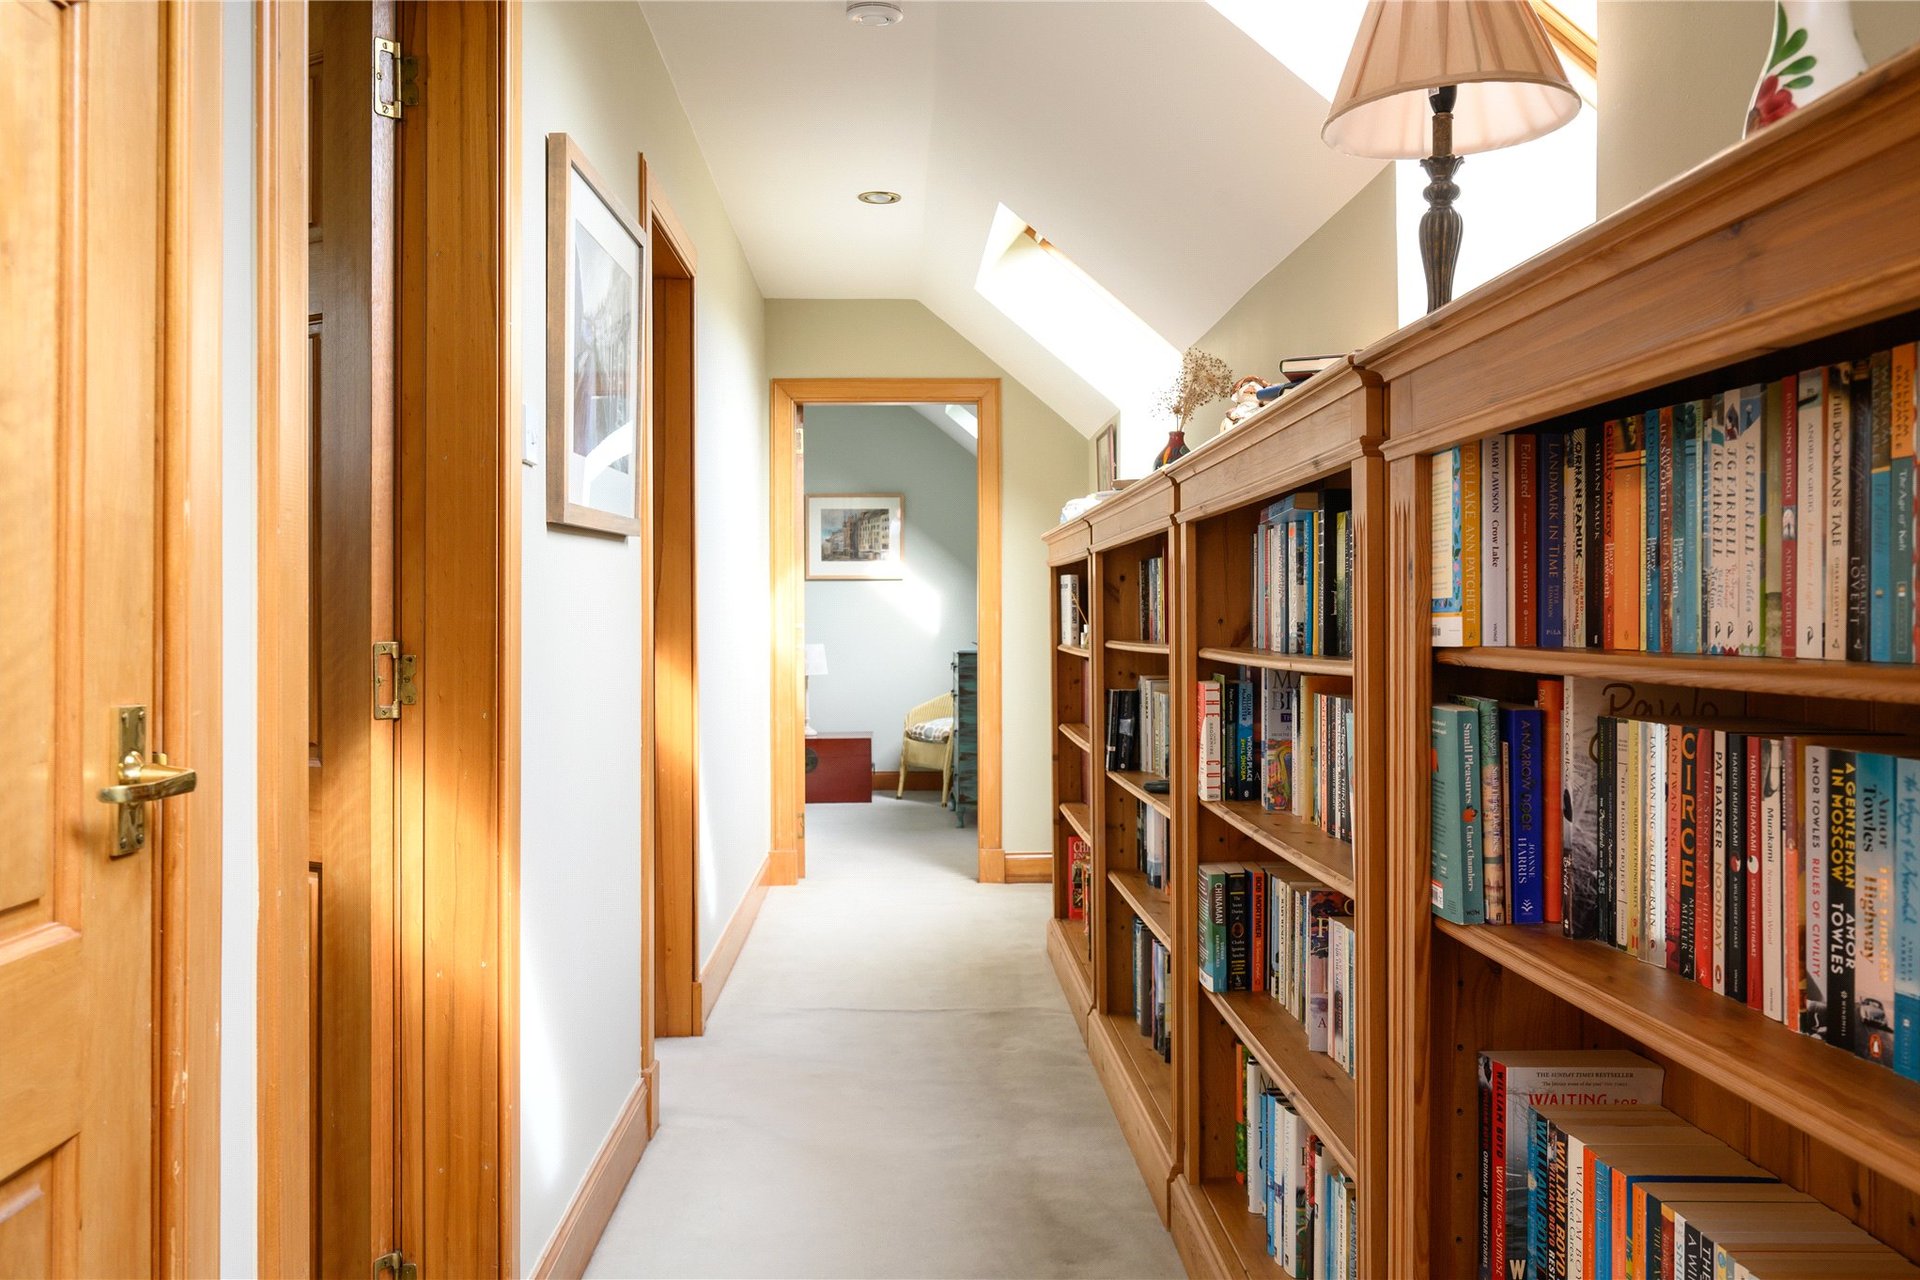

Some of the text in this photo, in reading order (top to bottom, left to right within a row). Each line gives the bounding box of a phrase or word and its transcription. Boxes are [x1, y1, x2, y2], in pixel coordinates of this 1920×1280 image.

[1832, 394, 1842, 419] THE
[1871, 365, 1880, 462] DALRYMPLE
[1880, 366, 1890, 446] WILLIAM
[1895, 364, 1903, 451] DALRYMPLE
[1903, 369, 1911, 437] WILLIAM
[1520, 444, 1531, 498] Educated
[1784, 392, 1793, 500] ROMANNO BRIDGE
[1807, 422, 1815, 513] ANDREW GREIG
[1491, 441, 1499, 513] MARY LAWSON
[1575, 441, 1583, 559] ORHAN PAMUK
[1647, 470, 1657, 527] VIRGIN
[1896, 489, 1907, 513] Age
[1898, 470, 1908, 488] The
[1464, 445, 1476, 624] TOM LAKE ANN PATCHETT
[1548, 443, 1560, 578] LANDMARK IN TIME
[1605, 490, 1613, 538] Mercy
[1712, 476, 1724, 559] FARRELL
[1725, 476, 1737, 559] FARRELL
[1744, 472, 1756, 556] FARRELL
[1831, 511, 1842, 547] TALE
[1491, 519, 1500, 567] Crow Lake
[1650, 537, 1658, 572] Barry
[1677, 538, 1685, 573] Barry
[1662, 559, 1670, 601] Marvels
[1745, 560, 1755, 613] Troubles
[1785, 547, 1793, 638] ANDREW GREIG
[1849, 557, 1860, 625] LOVETT
[1860, 564, 1868, 615] CHARLIE
[1205, 688, 1220, 791] THE CUT
[1489, 706, 1499, 756] Claire Keegan
[1463, 723, 1474, 804] Small Pleasures
[1491, 766, 1500, 786] Small
[1520, 732, 1532, 791] NARROW
[1489, 787, 1500, 813] Things
[1670, 735, 1678, 848] TAN TWAN ENG
[1681, 732, 1697, 887] CIRCE
[1862, 784, 1877, 854] Towles
[1878, 792, 1890, 849] Amor
[1491, 830, 1500, 852] These
[1714, 751, 1723, 952] PAT BARKER NOONDAY
[1750, 794, 1758, 852] MURAKAMI
[1767, 807, 1775, 863] Murakami
[1831, 768, 1843, 882] IN MOSCOW
[1845, 763, 1856, 889] A GENTLEMAN
[1466, 825, 1476, 892] Clare Chambers
[1518, 837, 1528, 885] HARRIS
[1528, 843, 1536, 878] JOANNE
[1563, 857, 1573, 897] Brida
[1598, 870, 1606, 894] A35
[1811, 756, 1821, 978] AMOR TOWLES RULES OF CIVILITY
[1215, 882, 1223, 924] CHINAMAN
[1860, 875, 1877, 965] Highway
[1830, 902, 1843, 975] TOWLES
[1845, 913, 1856, 970] AMOR
[1496, 1071, 1505, 1121] WILLIAM
[1528, 1093, 1608, 1105] WAITING
[1496, 1126, 1504, 1159] BOYD
[1496, 1165, 1504, 1211] WAITING
[1536, 1119, 1547, 1271] WILLIAM BOYD
[1556, 1140, 1567, 1277] WILLIAM BOYD
[1575, 1165, 1583, 1241] WILLIAM
[1495, 1229, 1504, 1277] SUNRISE
